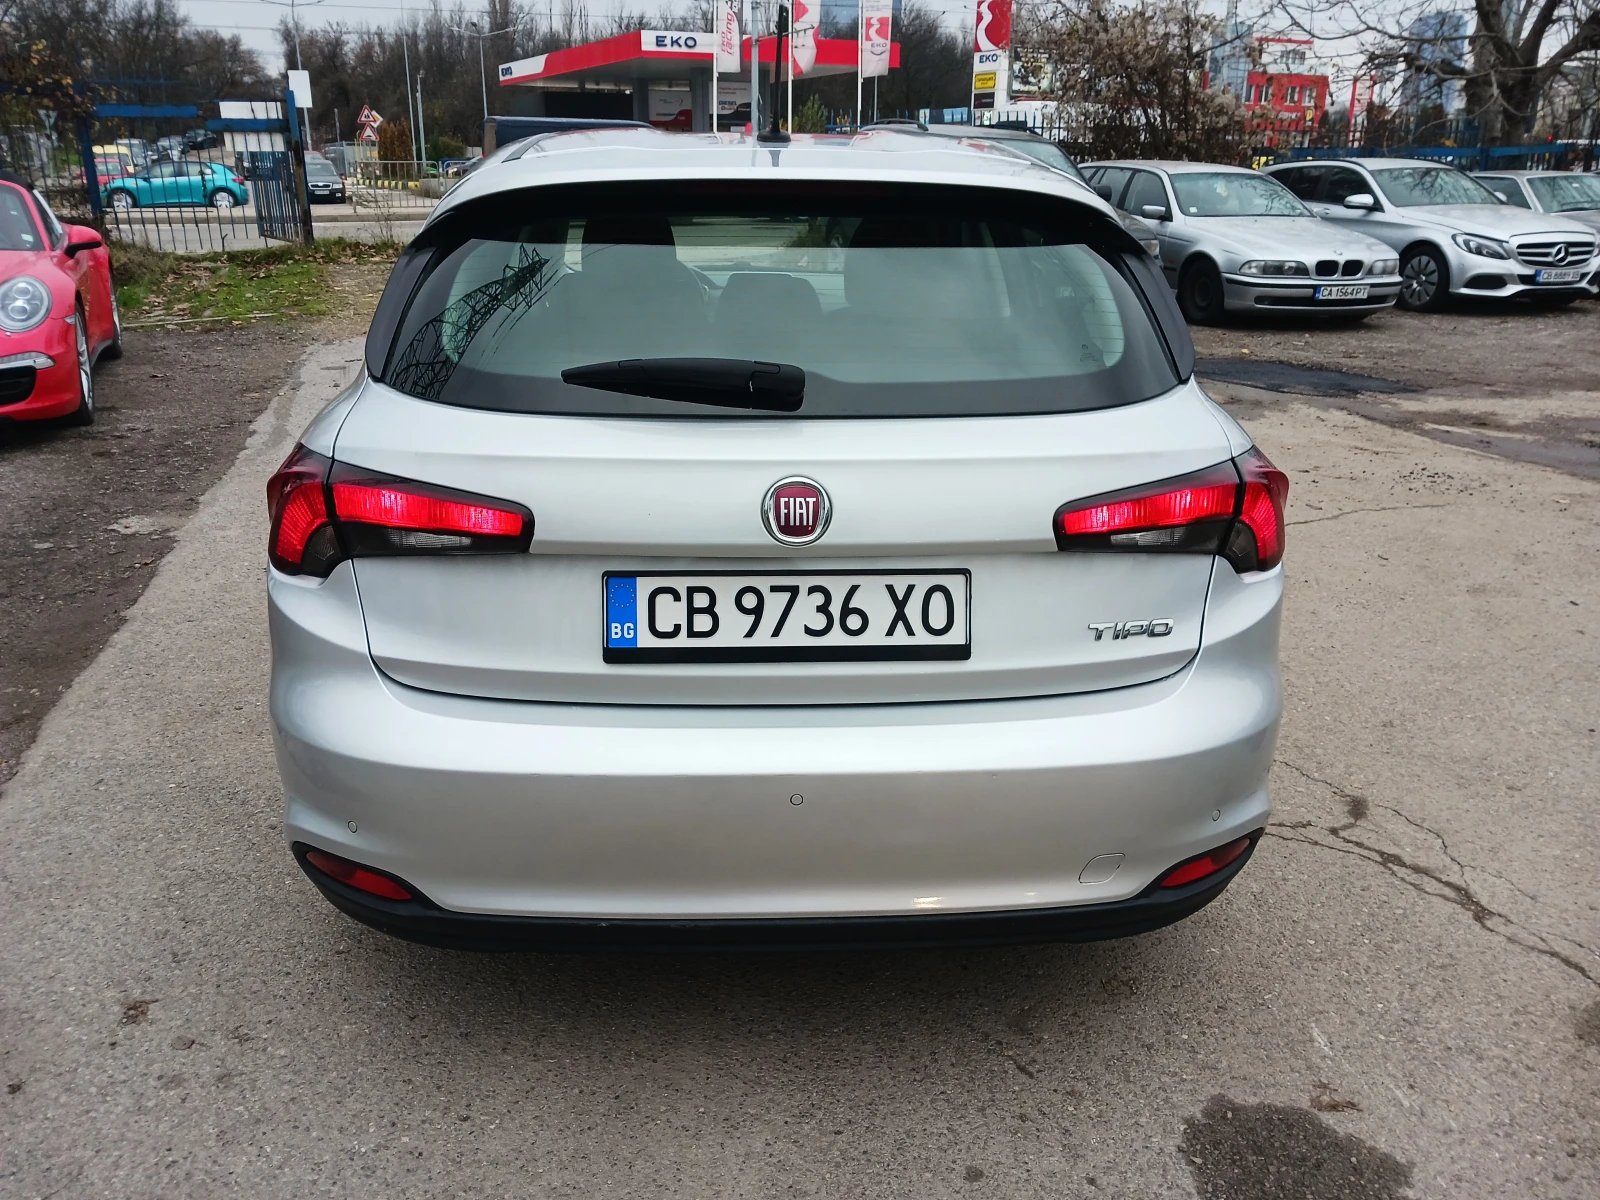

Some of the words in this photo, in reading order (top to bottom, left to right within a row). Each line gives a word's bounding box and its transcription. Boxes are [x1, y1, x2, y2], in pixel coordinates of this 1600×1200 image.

[655, 35, 697, 49] EKO
[725, 11, 735, 56] racing
[979, 53, 999, 64] EKO
[1321, 287, 1333, 298] CA
[1335, 287, 1355, 298] 1564
[1355, 287, 1368, 297] PT
[779, 497, 816, 526] FIAT
[647, 585, 720, 640] CB
[734, 583, 870, 640] 9736
[884, 582, 956, 638] XO
[610, 622, 635, 640] BG
[1088, 618, 1174, 641] TIPO
